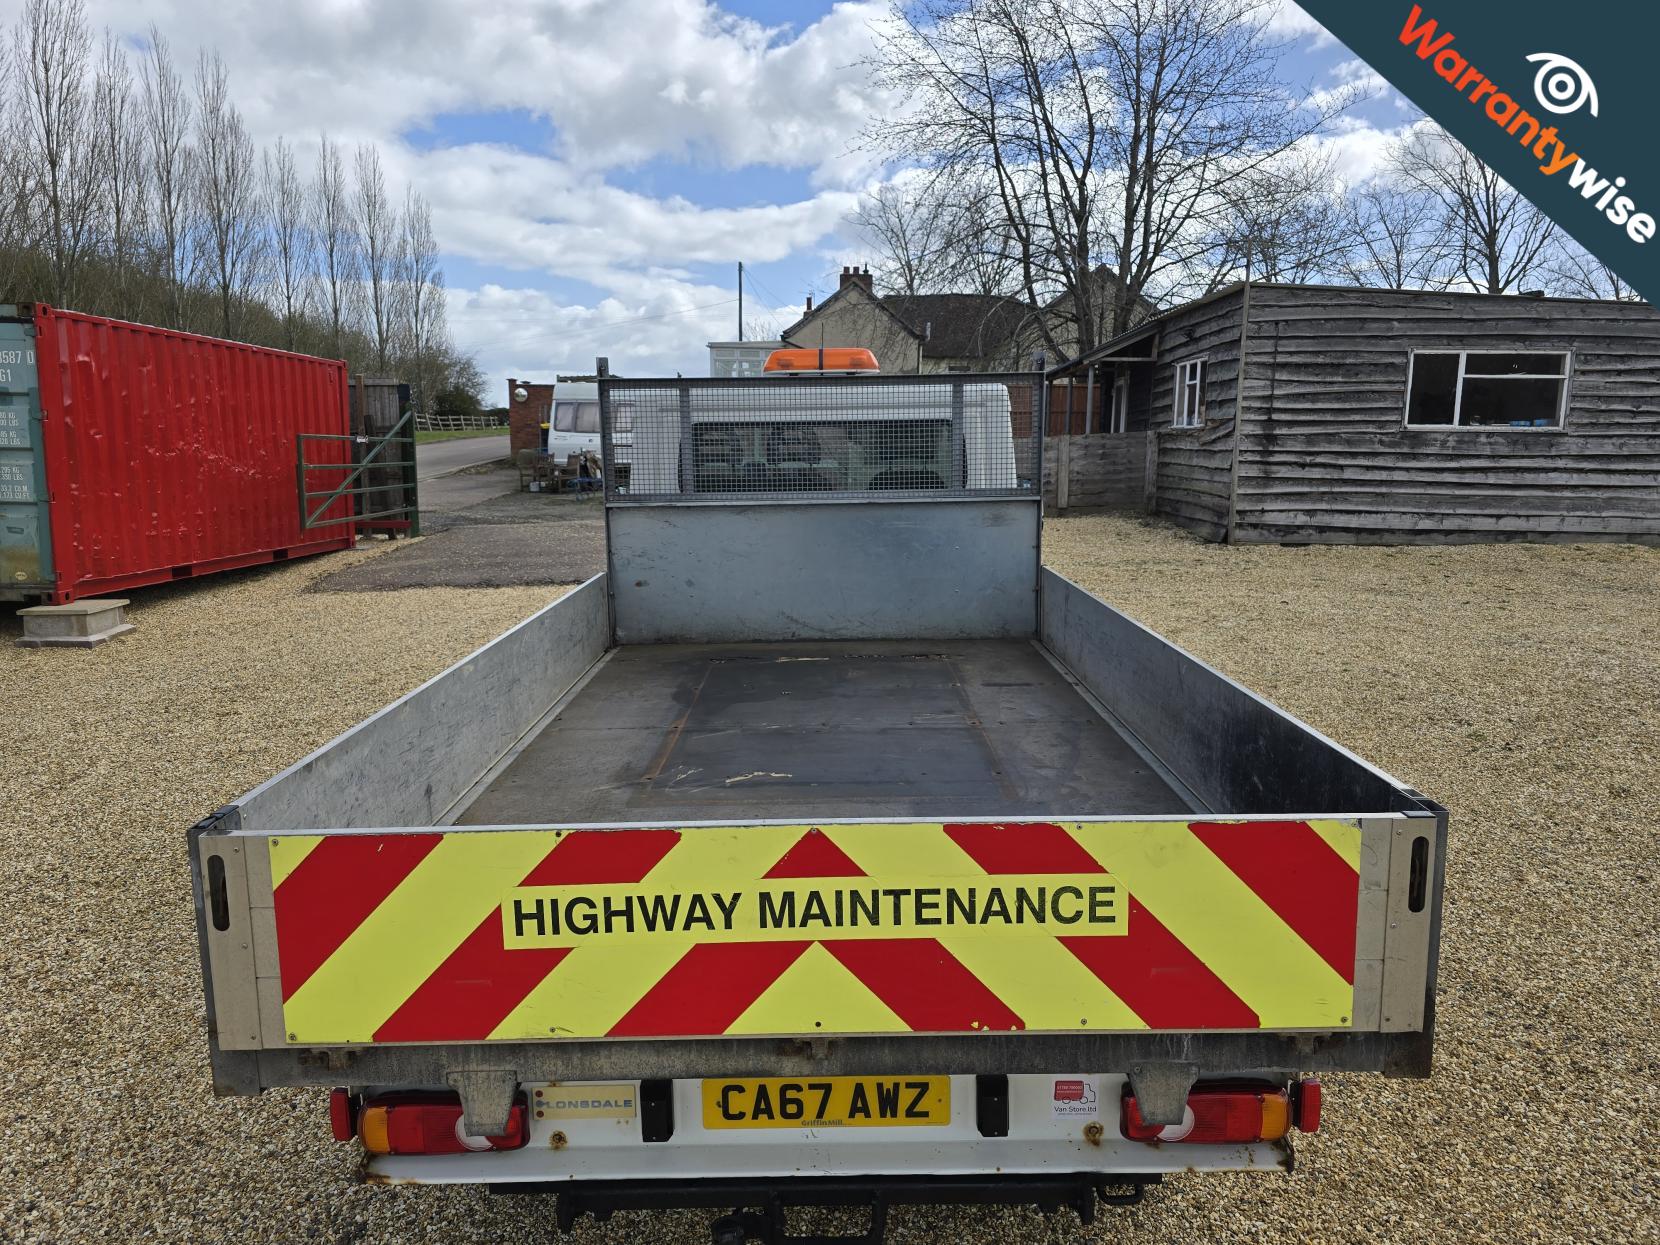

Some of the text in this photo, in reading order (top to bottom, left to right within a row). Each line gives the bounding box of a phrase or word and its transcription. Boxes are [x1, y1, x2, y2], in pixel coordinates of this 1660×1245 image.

[513, 886, 1117, 937] HIGHWAY MAINTENANCE
[546, 1099, 633, 1109] LONSDALE
[721, 1082, 930, 1121] CA67 AWZ
